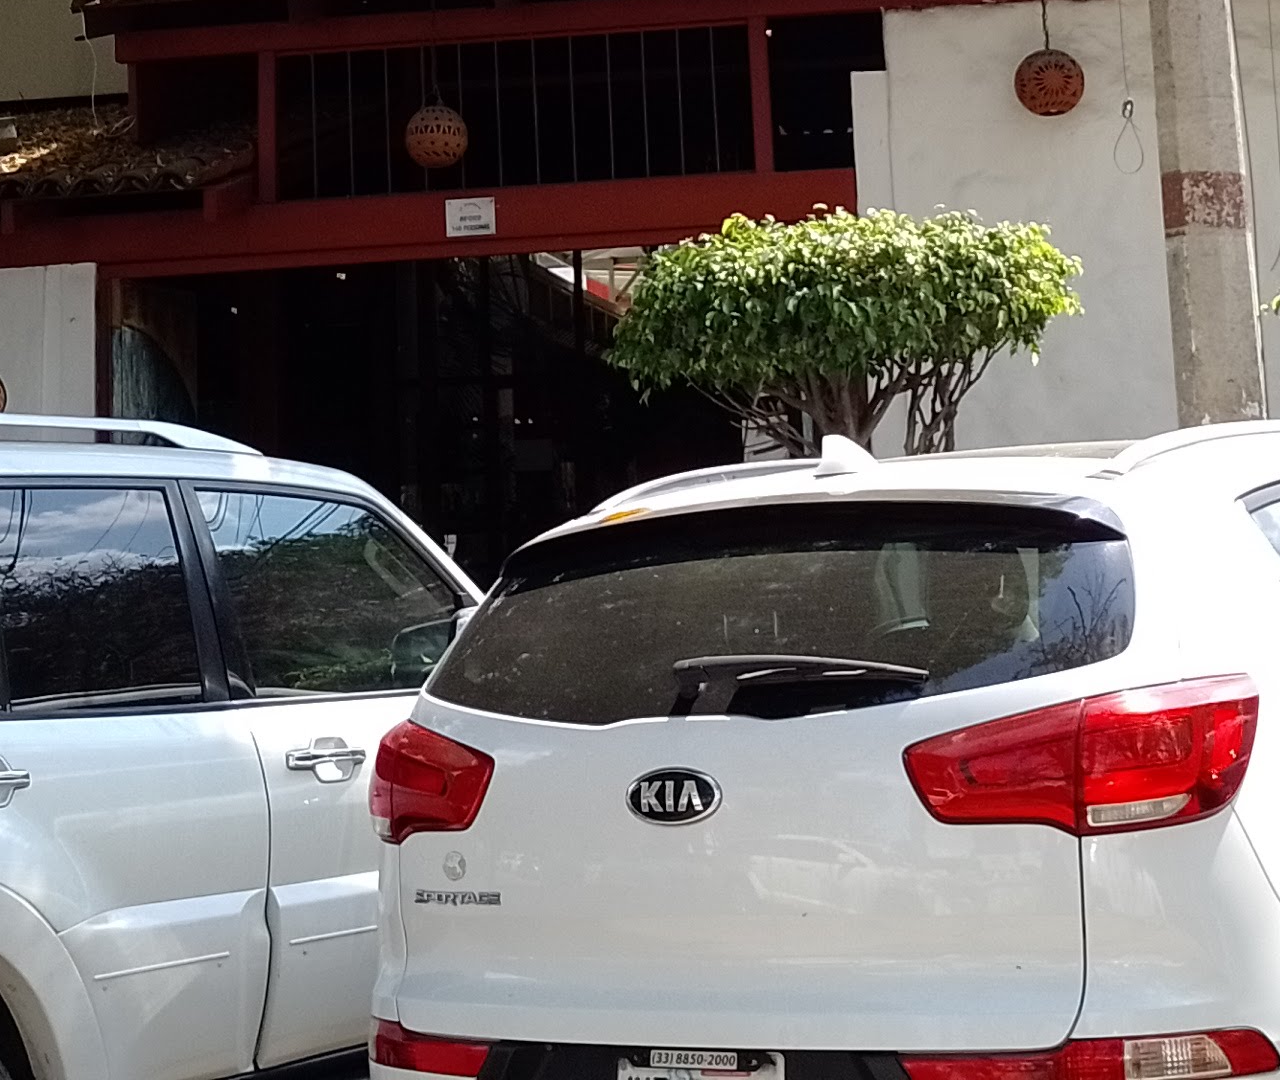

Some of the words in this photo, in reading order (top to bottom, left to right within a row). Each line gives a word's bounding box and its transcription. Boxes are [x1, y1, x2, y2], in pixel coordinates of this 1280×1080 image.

[640, 780, 704, 813] KIA
[414, 889, 502, 907] SPORTAGE
[651, 1051, 673, 1065] (33)
[675, 1053, 737, 1067] 8850-2000
